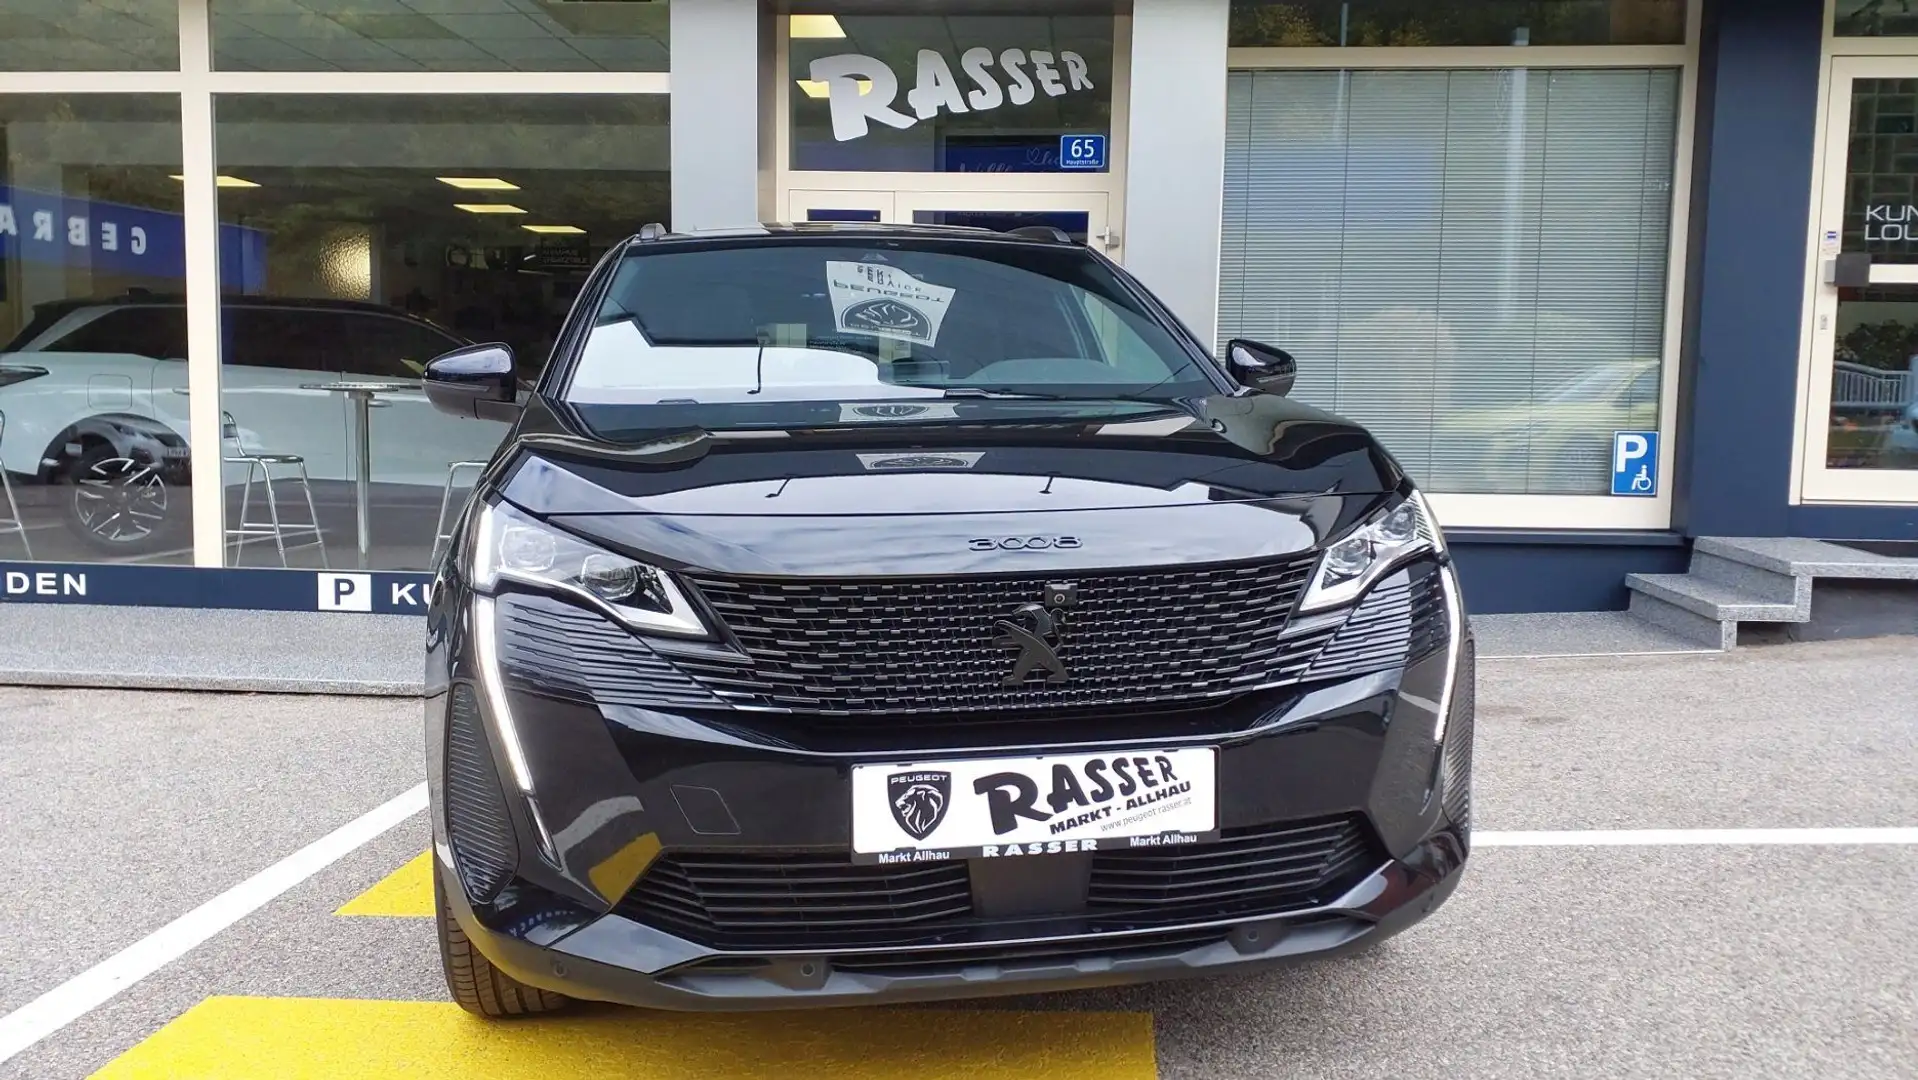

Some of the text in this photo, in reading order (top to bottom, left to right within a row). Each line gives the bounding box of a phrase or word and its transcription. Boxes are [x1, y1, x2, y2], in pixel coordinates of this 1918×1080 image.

[809, 47, 1094, 141] RASSER
[1071, 139, 1095, 158] 65
[1616, 434, 1648, 472] P
[968, 536, 1083, 551] 3008
[6, 571, 87, 596] DEN
[334, 578, 355, 605] P
[891, 774, 947, 784] PEUGEOT
[973, 755, 1178, 836] RASSER
[1049, 805, 1112, 835] MARKT
[1126, 780, 1191, 811] ALLHAU
[982, 838, 1098, 858] RASSER
[1130, 833, 1198, 848] Markt Allhau
[879, 850, 950, 864] Markt Allhau
